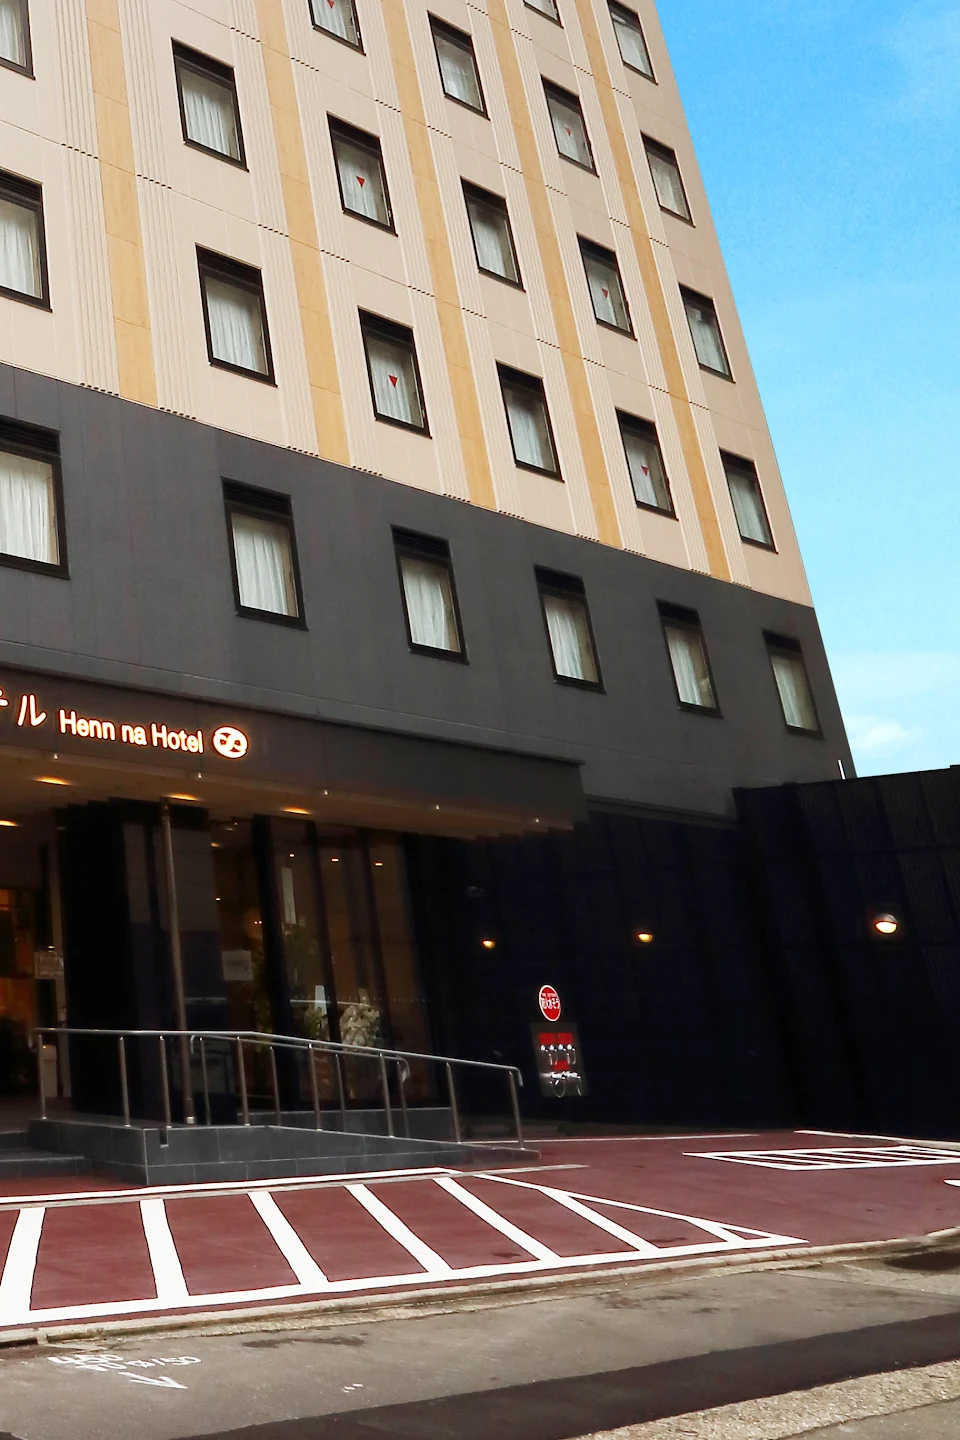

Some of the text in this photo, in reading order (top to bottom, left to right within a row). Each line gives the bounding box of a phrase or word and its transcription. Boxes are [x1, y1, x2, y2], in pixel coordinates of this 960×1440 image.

[59, 709, 115, 741] Henn
[121, 724, 148, 746] na
[151, 722, 204, 754] Hotel
